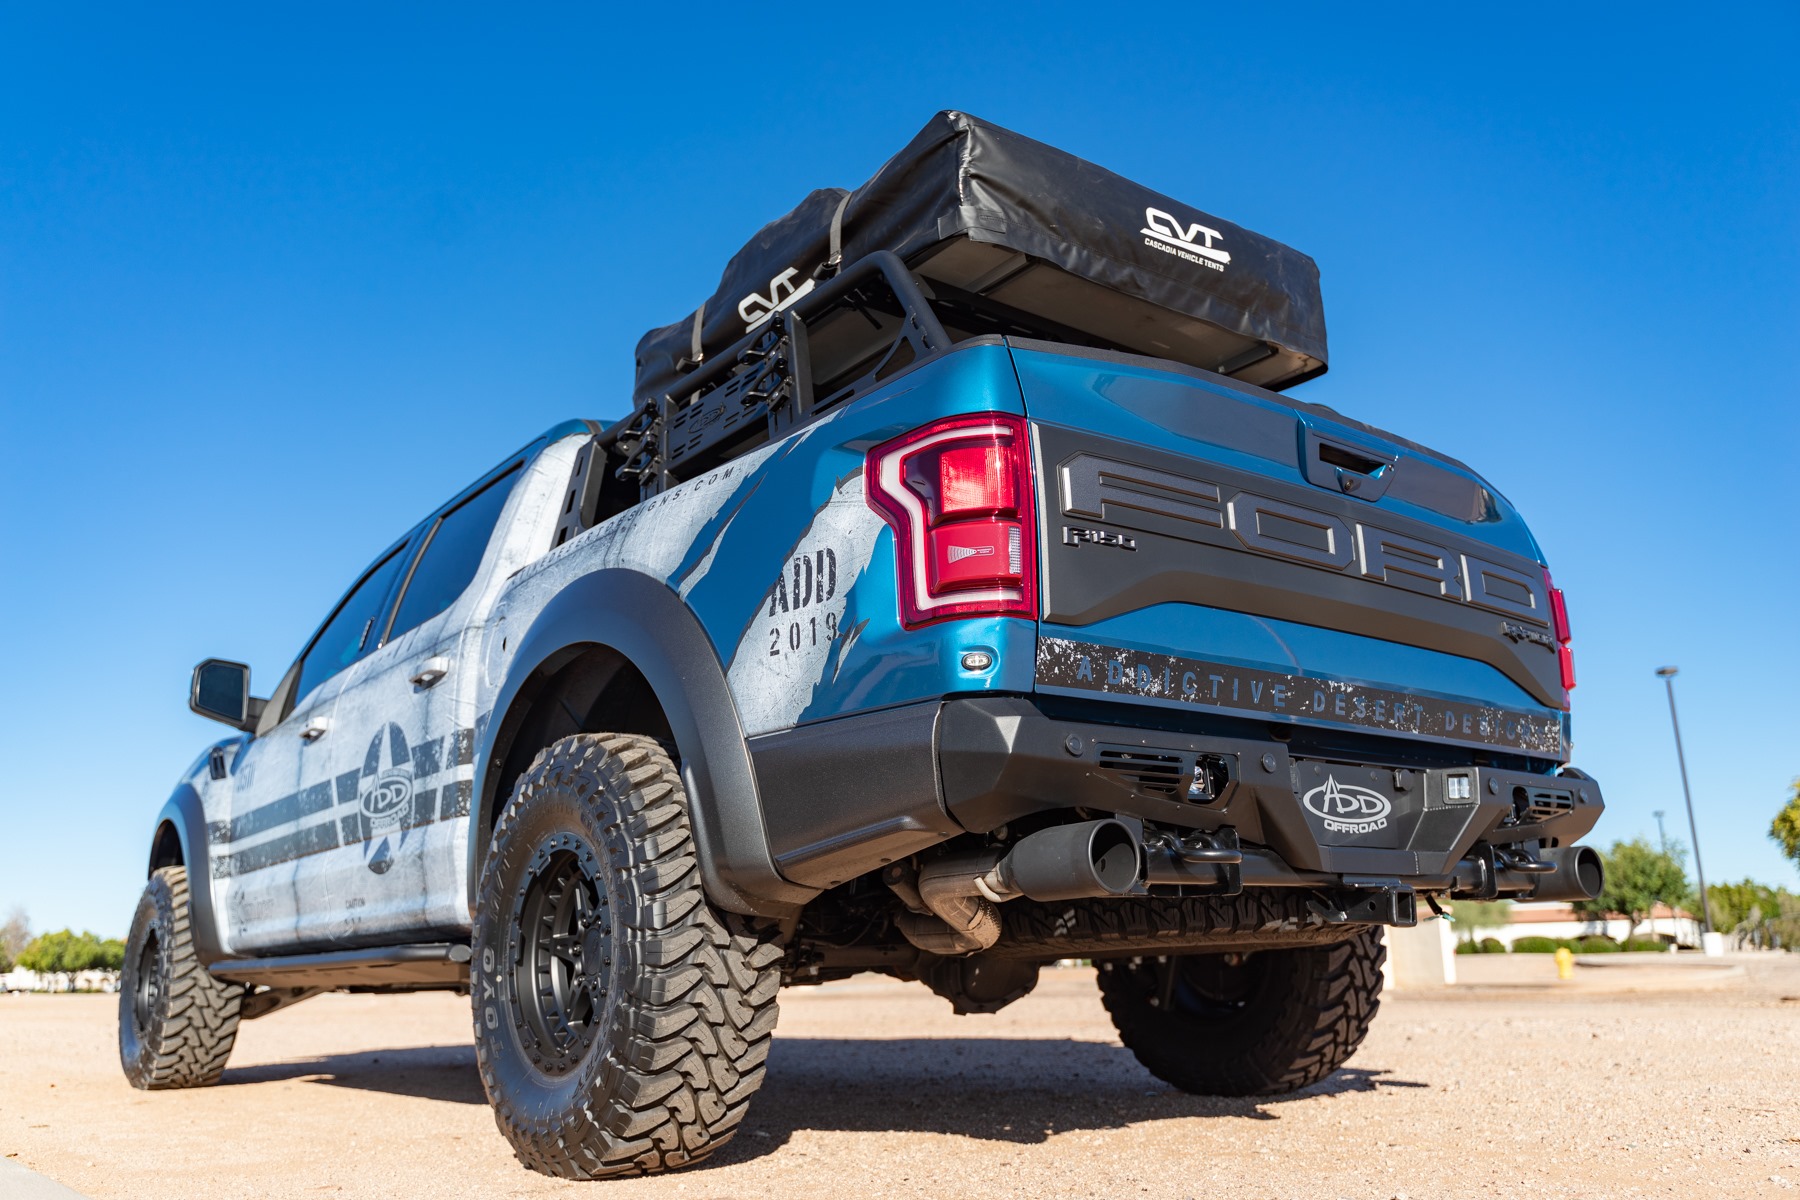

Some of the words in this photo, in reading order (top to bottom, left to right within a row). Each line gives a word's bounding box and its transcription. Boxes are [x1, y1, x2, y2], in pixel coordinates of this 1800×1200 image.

[1145, 207, 1224, 249] CVT
[1144, 237, 1177, 256] CASCADIA
[1177, 248, 1204, 265] VEHICLE
[1204, 258, 1225, 273] TENTS
[738, 266, 799, 323] CVT
[1062, 526, 1138, 552] F150
[1062, 450, 1551, 630] FORD
[769, 547, 837, 617] ADD
[769, 612, 837, 657] 2019
[1076, 655, 1286, 708] ADDICTIVE
[1313, 689, 1423, 727] DESERT
[1324, 817, 1388, 834] OFFROAD
[482, 945, 506, 1060] TOYO
